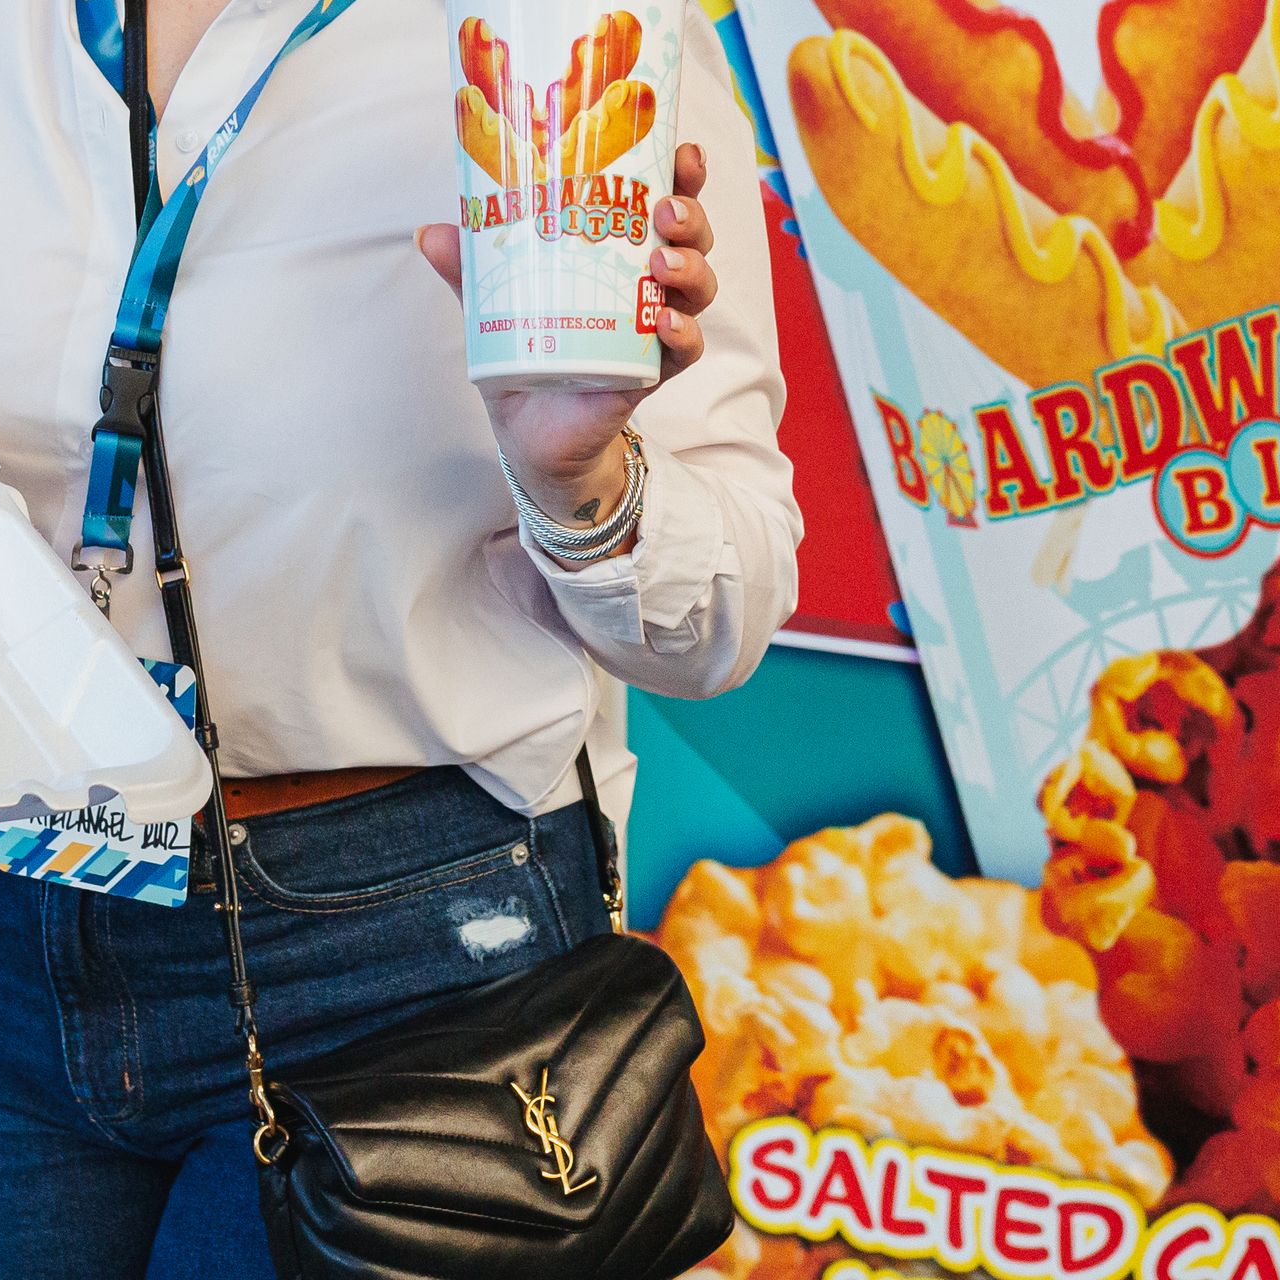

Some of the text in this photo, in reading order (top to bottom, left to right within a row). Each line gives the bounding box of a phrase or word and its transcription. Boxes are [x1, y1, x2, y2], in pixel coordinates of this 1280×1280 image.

[540, 208, 646, 241] BITES
[641, 306, 662, 327] CU
[748, 1135, 1128, 1275] SALTED
